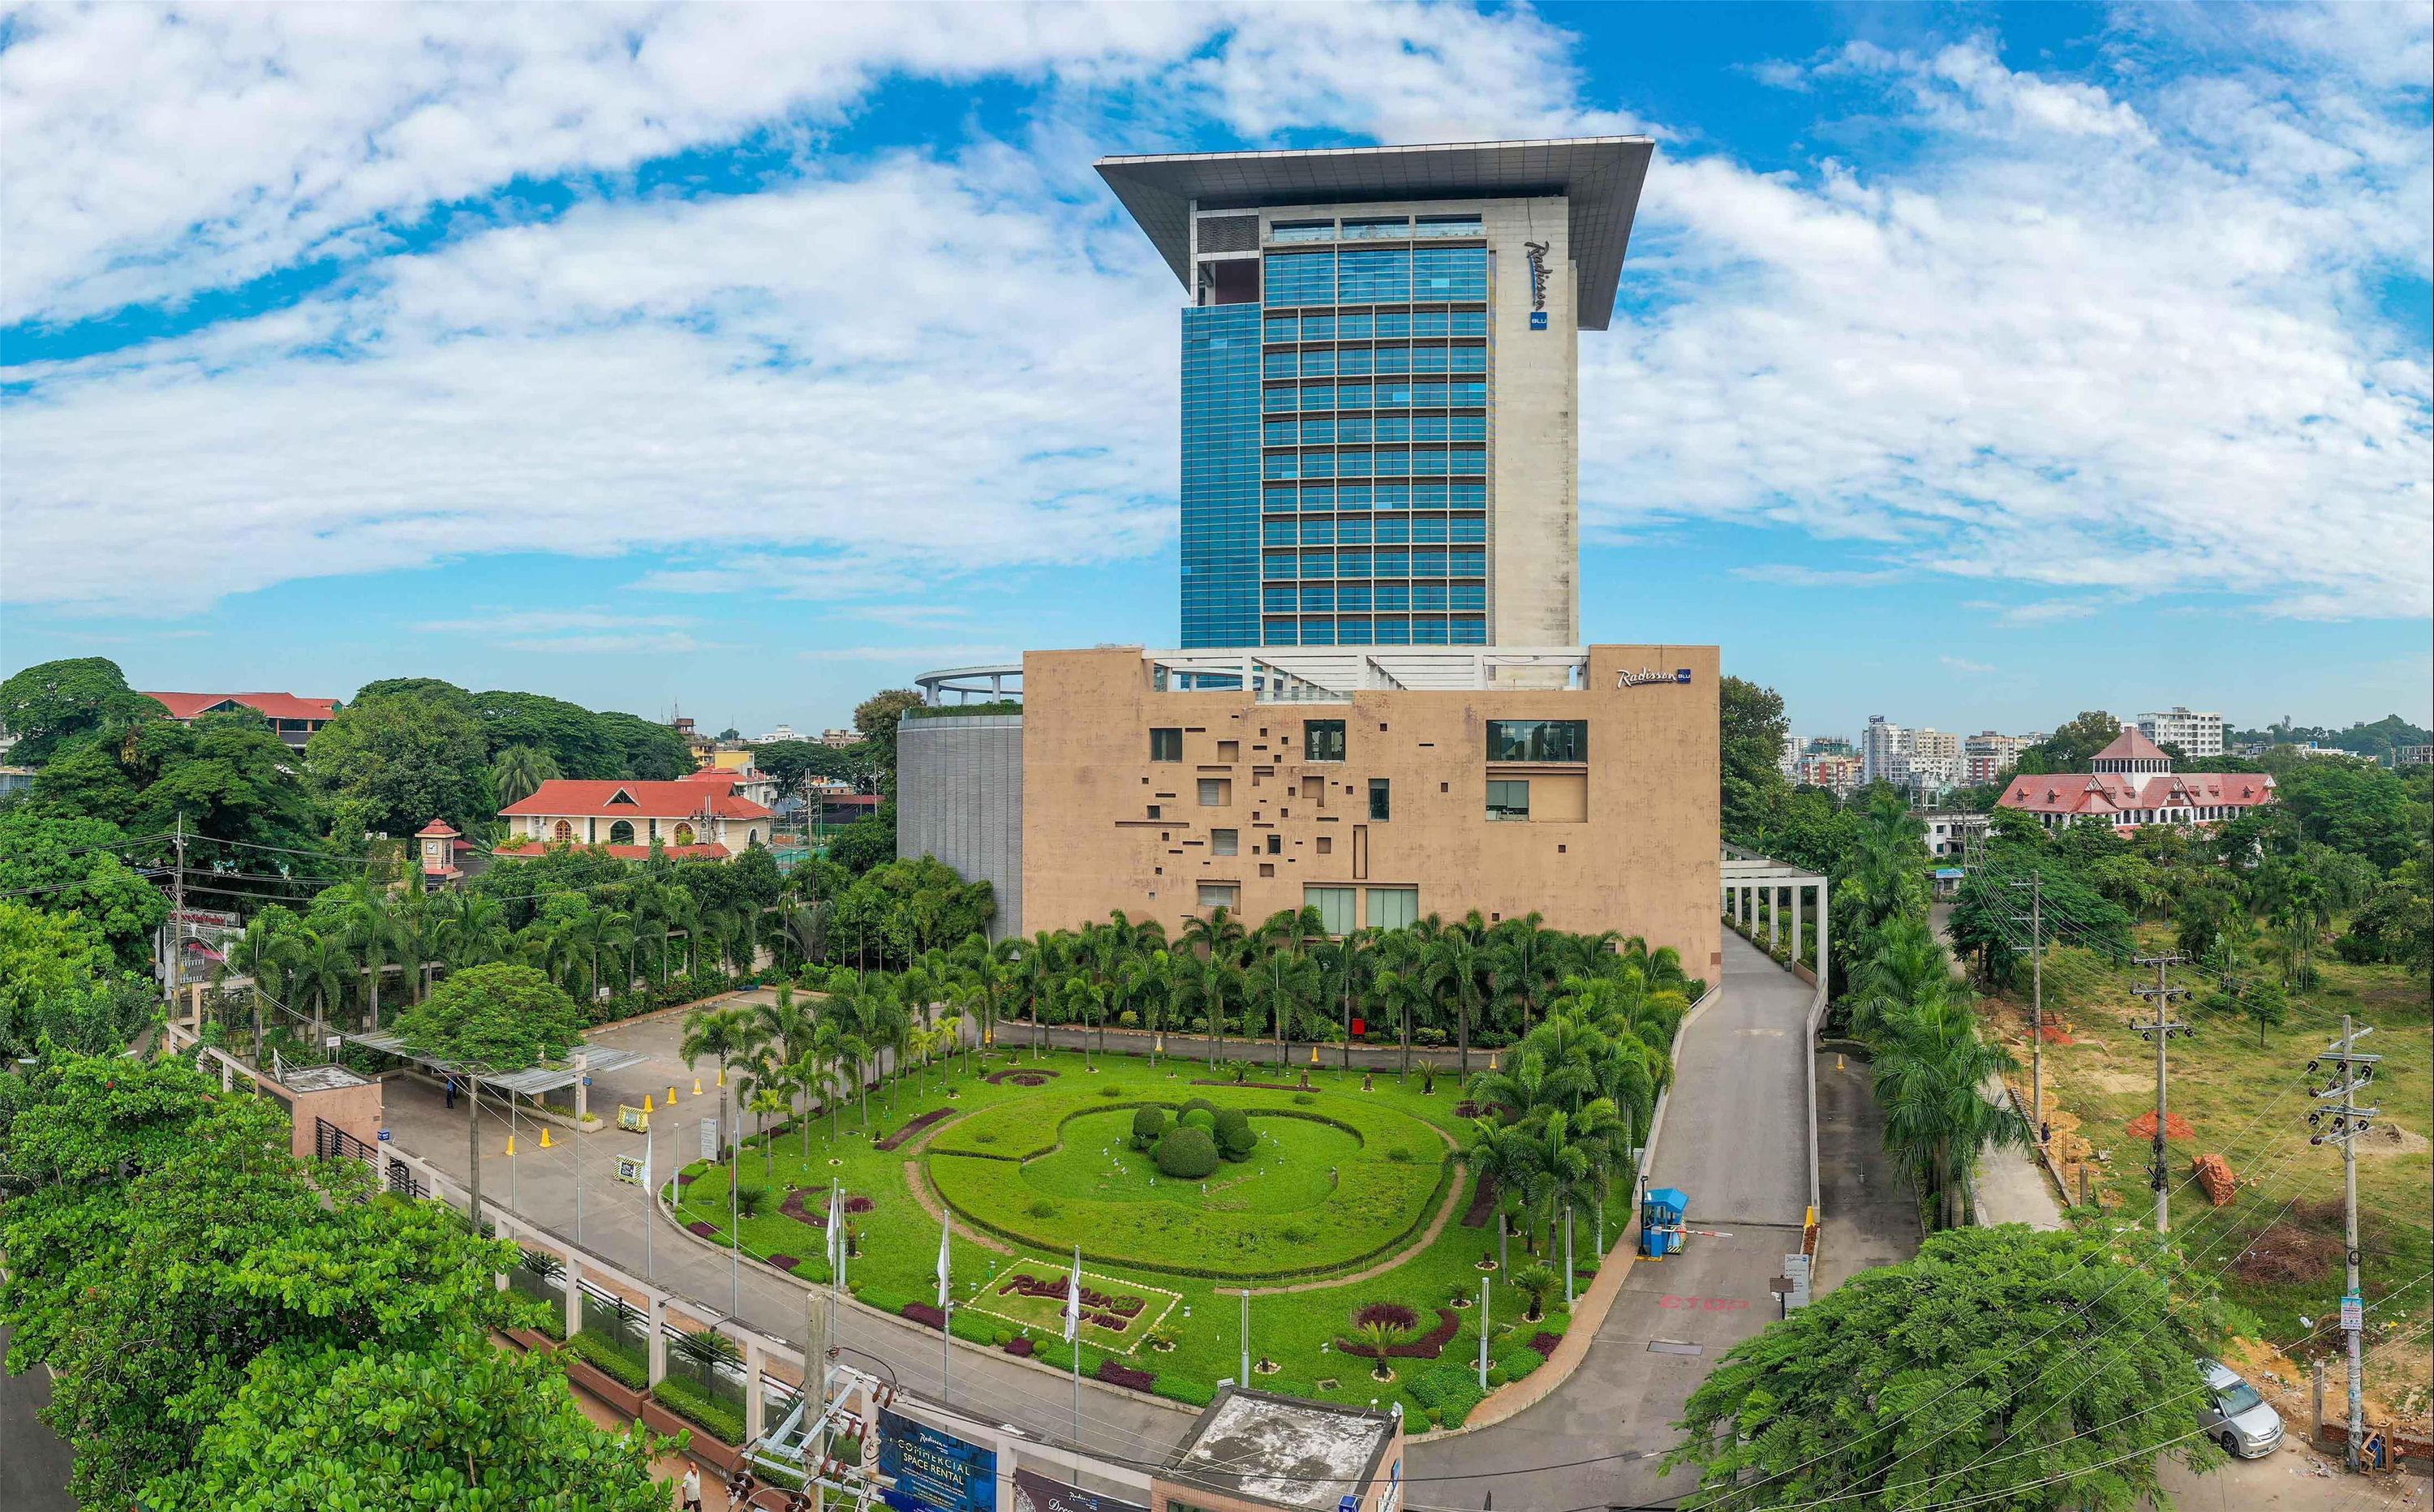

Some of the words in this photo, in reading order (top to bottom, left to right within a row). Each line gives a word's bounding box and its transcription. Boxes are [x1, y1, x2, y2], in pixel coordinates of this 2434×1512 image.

[1524, 241, 1553, 311] Radisson
[1616, 666, 1677, 689] Radisson
[897, 1439, 970, 1476] COMMERCIAL
[903, 1453, 929, 1471] SPACE
[931, 1463, 964, 1486] RENTAL
